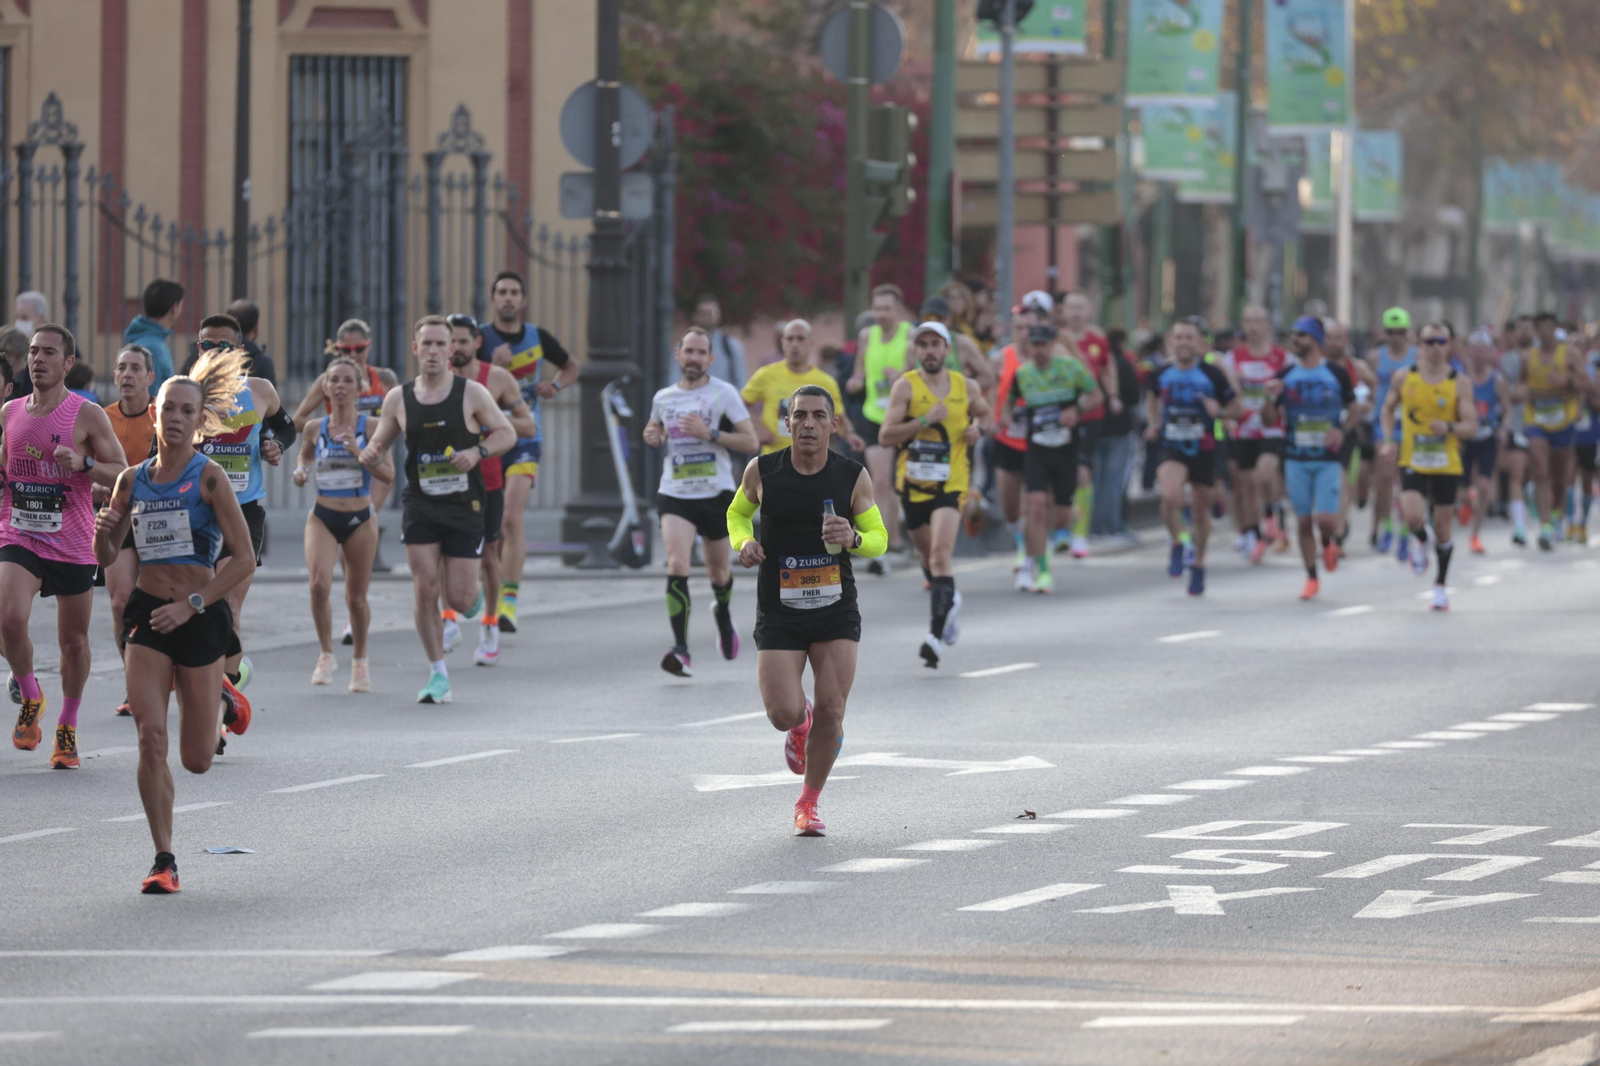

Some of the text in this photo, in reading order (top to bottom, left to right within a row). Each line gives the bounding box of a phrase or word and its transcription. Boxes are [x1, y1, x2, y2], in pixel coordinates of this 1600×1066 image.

[215, 446, 246, 454] ZURICH
[25, 485, 57, 495] ZURICH
[25, 500, 43, 510] 1801
[146, 499, 181, 512] ZURICH
[19, 511, 52, 521] RUBEN GSA
[147, 519, 168, 531] F229
[145, 534, 175, 545] ADRIANA
[799, 556, 832, 567] ZURICH
[800, 575, 821, 585] 3893
[803, 589, 821, 597] FHER
